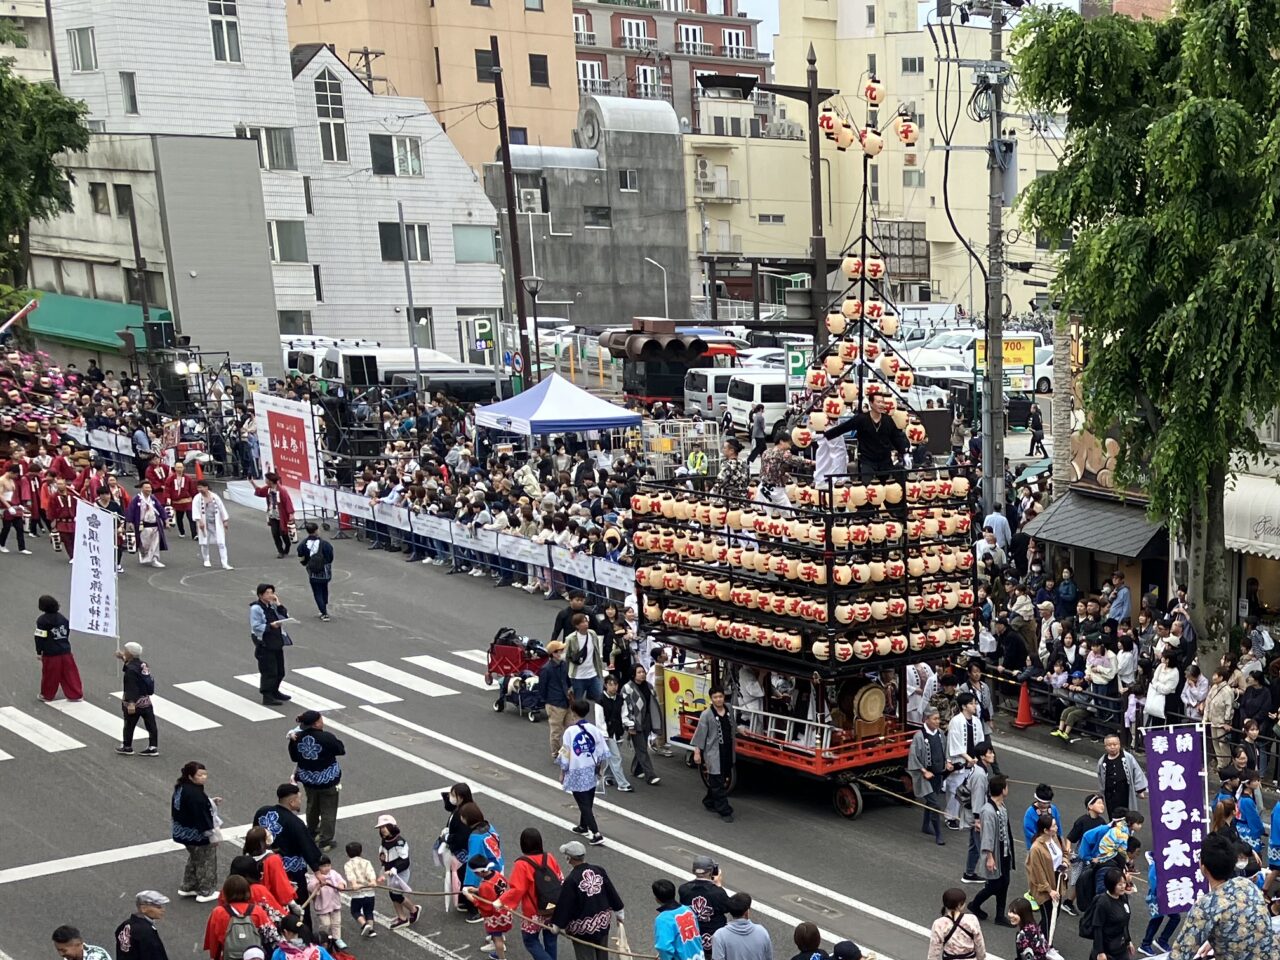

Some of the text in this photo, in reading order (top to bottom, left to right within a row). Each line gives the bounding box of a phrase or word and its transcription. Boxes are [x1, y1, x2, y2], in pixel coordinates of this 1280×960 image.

[475, 319, 491, 340] P
[1003, 341, 1022, 351] 700
[788, 351, 804, 375] P
[1152, 733, 1193, 754] 奉納
[1157, 760, 1195, 908] 丸子太鼓
